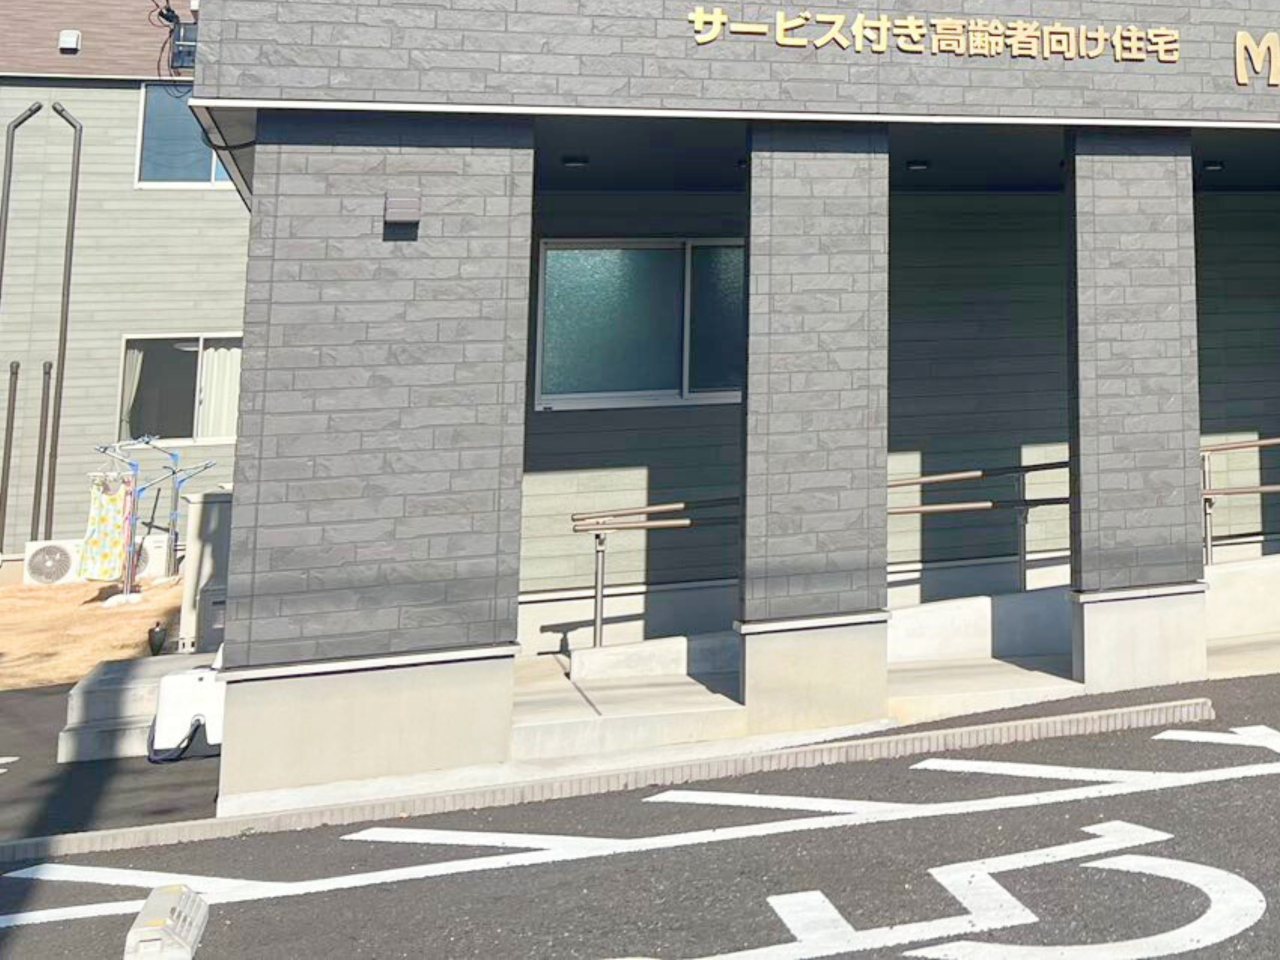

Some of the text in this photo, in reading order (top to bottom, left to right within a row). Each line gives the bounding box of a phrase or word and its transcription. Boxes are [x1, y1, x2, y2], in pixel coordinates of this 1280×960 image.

[688, 6, 1180, 62] サービス付き高齢者向け住宅
